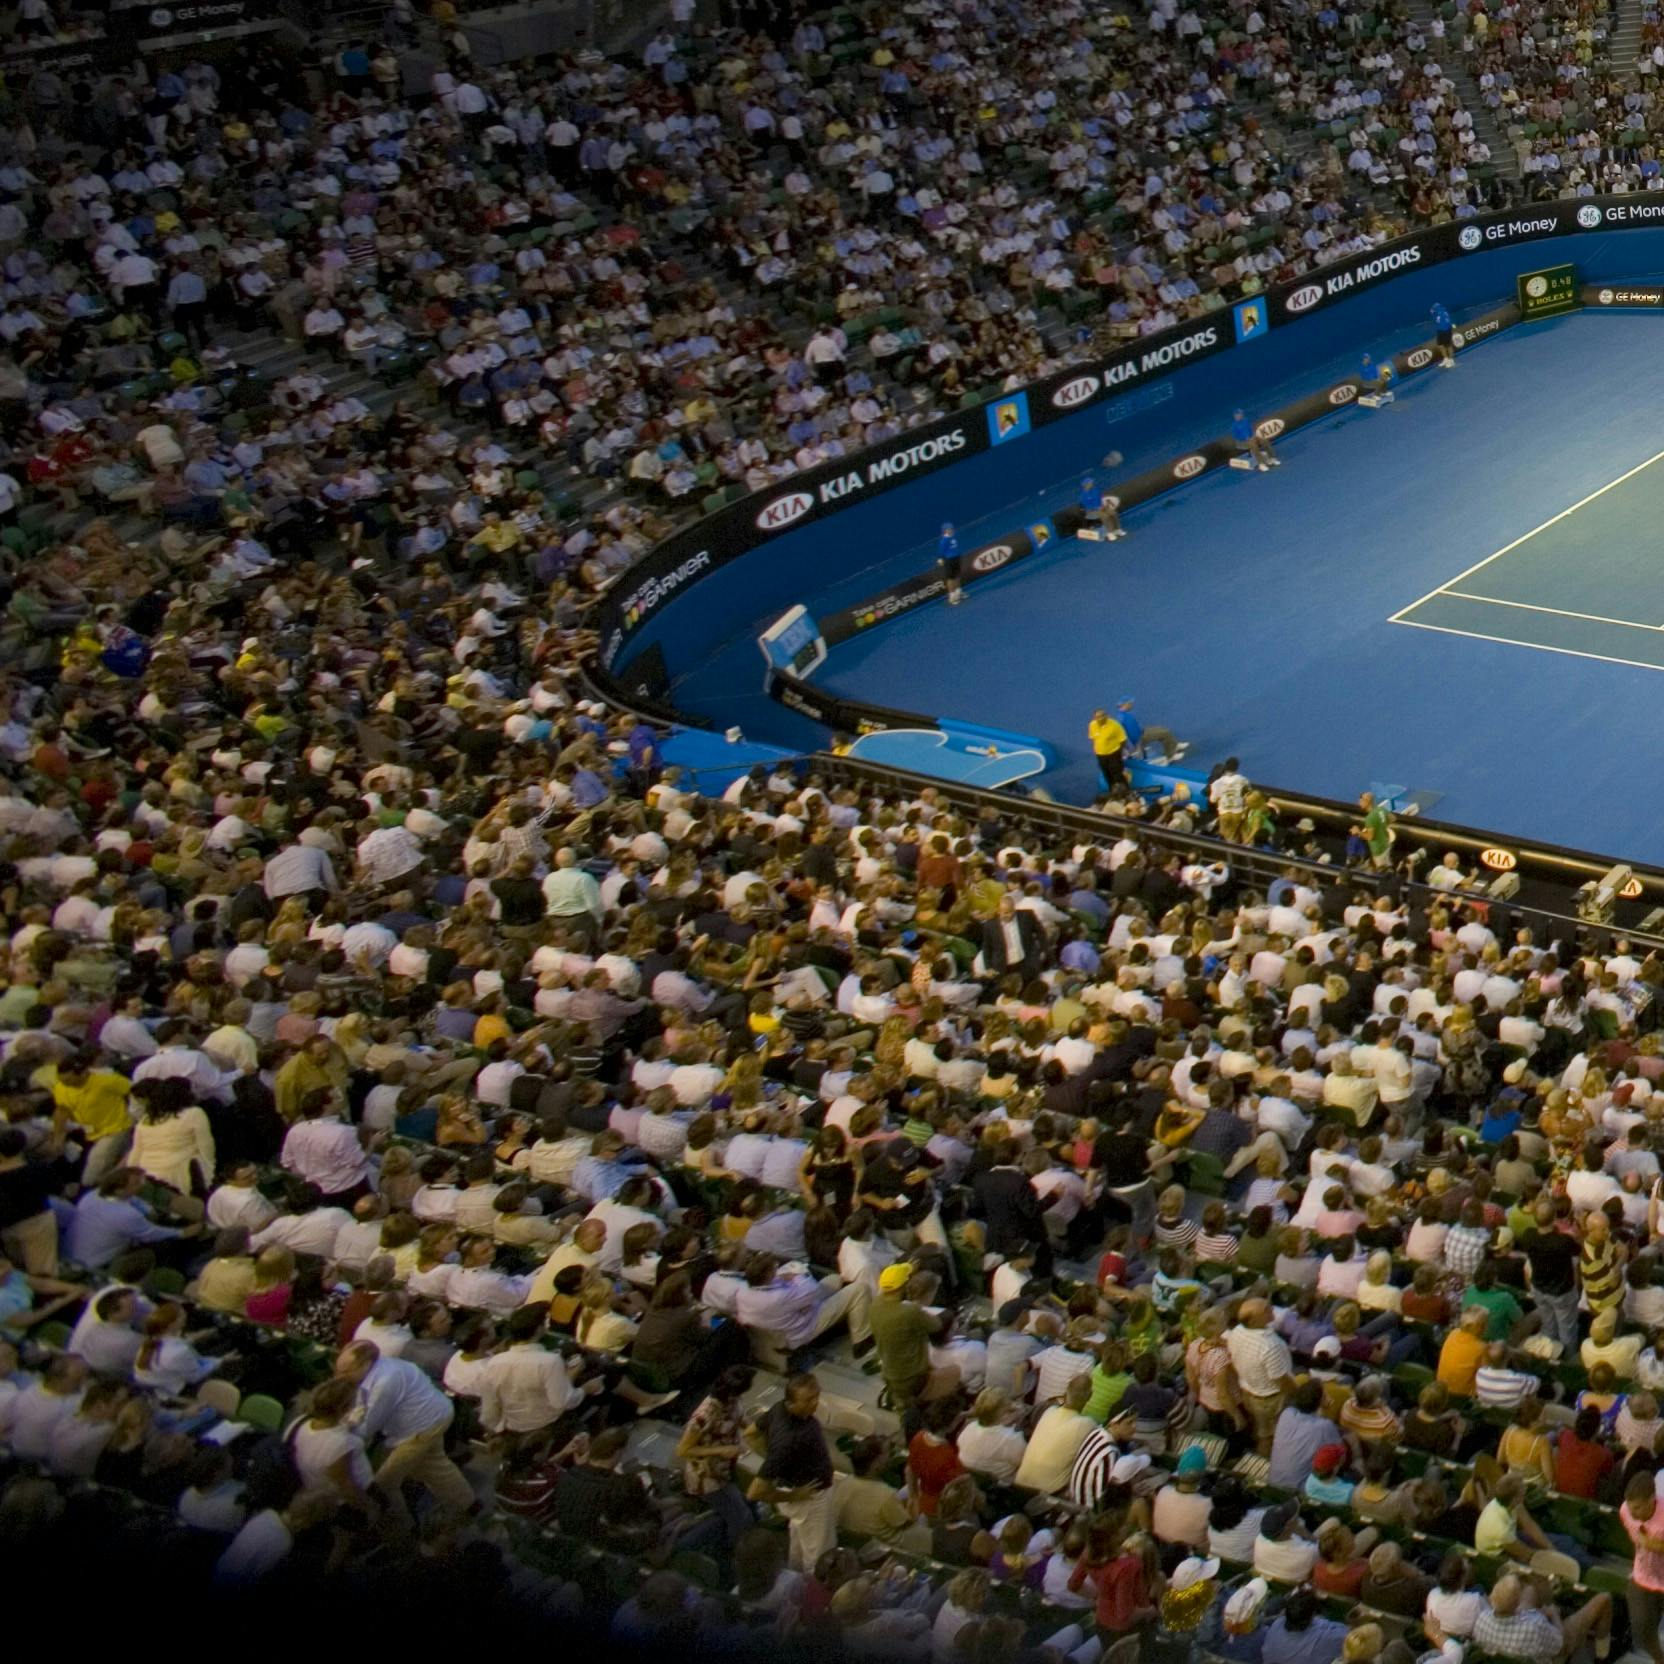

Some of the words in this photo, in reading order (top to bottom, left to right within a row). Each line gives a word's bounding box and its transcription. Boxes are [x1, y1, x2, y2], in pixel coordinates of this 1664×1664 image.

[1606, 206, 1627, 220] GE
[1485, 225, 1506, 240] GE
[1508, 218, 1558, 237] Money
[1290, 287, 1321, 310] KIA
[1327, 274, 1354, 295] KIA
[1356, 245, 1422, 284] MOTORS
[1058, 377, 1094, 406] KIA
[1104, 361, 1138, 387] KIA
[1141, 326, 1218, 372] MOTORS
[765, 495, 811, 525] KIA
[820, 472, 865, 504] KIA
[868, 428, 967, 485] MOTORS
[1177, 458, 1205, 477] KIA
[976, 546, 1010, 570] KIA
[1486, 850, 1511, 868] KIA
